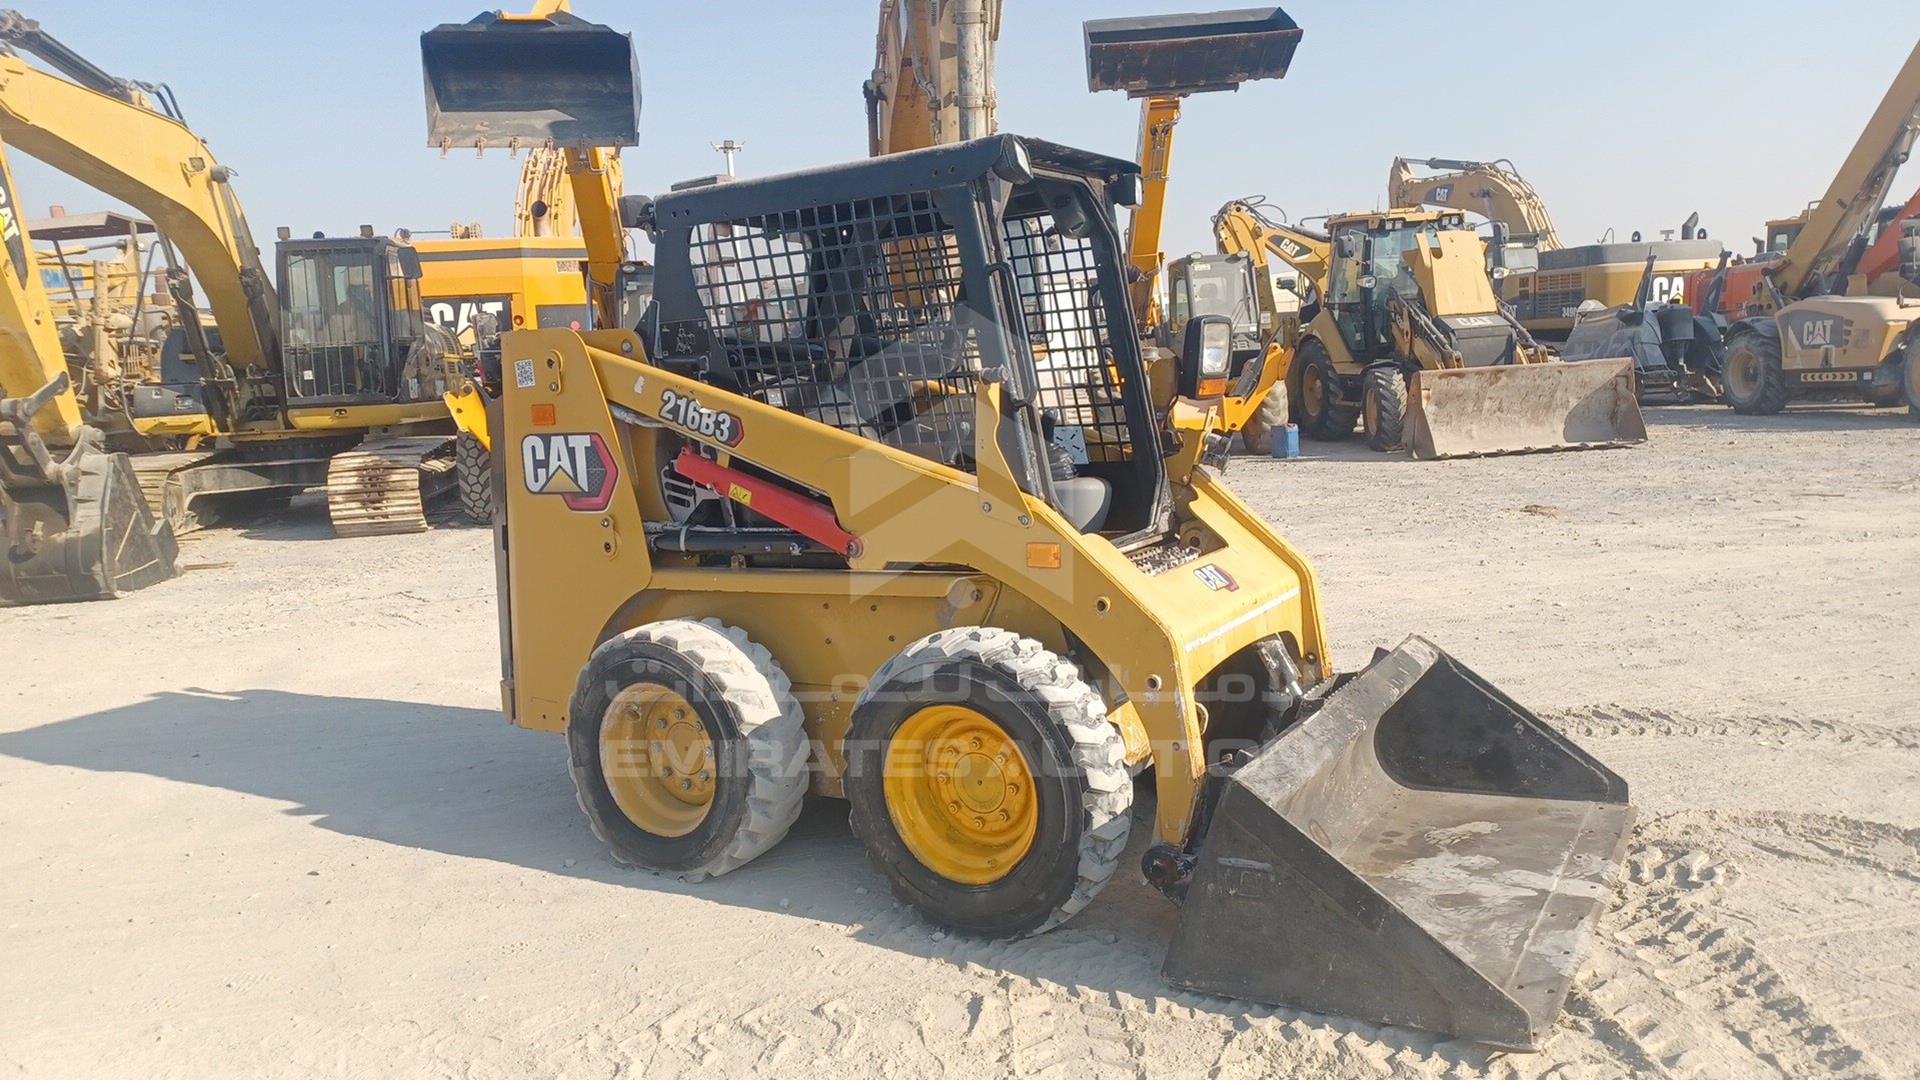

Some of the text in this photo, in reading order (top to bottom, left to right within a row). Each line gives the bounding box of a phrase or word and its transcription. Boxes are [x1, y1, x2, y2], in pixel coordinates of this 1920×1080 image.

[1436, 187, 1449, 198] CAT
[1279, 238, 1301, 256] CAT
[1653, 276, 1685, 304] CA
[1456, 316, 1494, 327] CAT
[1803, 319, 1834, 346] CAT
[660, 389, 732, 443] 216B3
[522, 434, 592, 493] CAT
[1193, 564, 1230, 591] CAT
